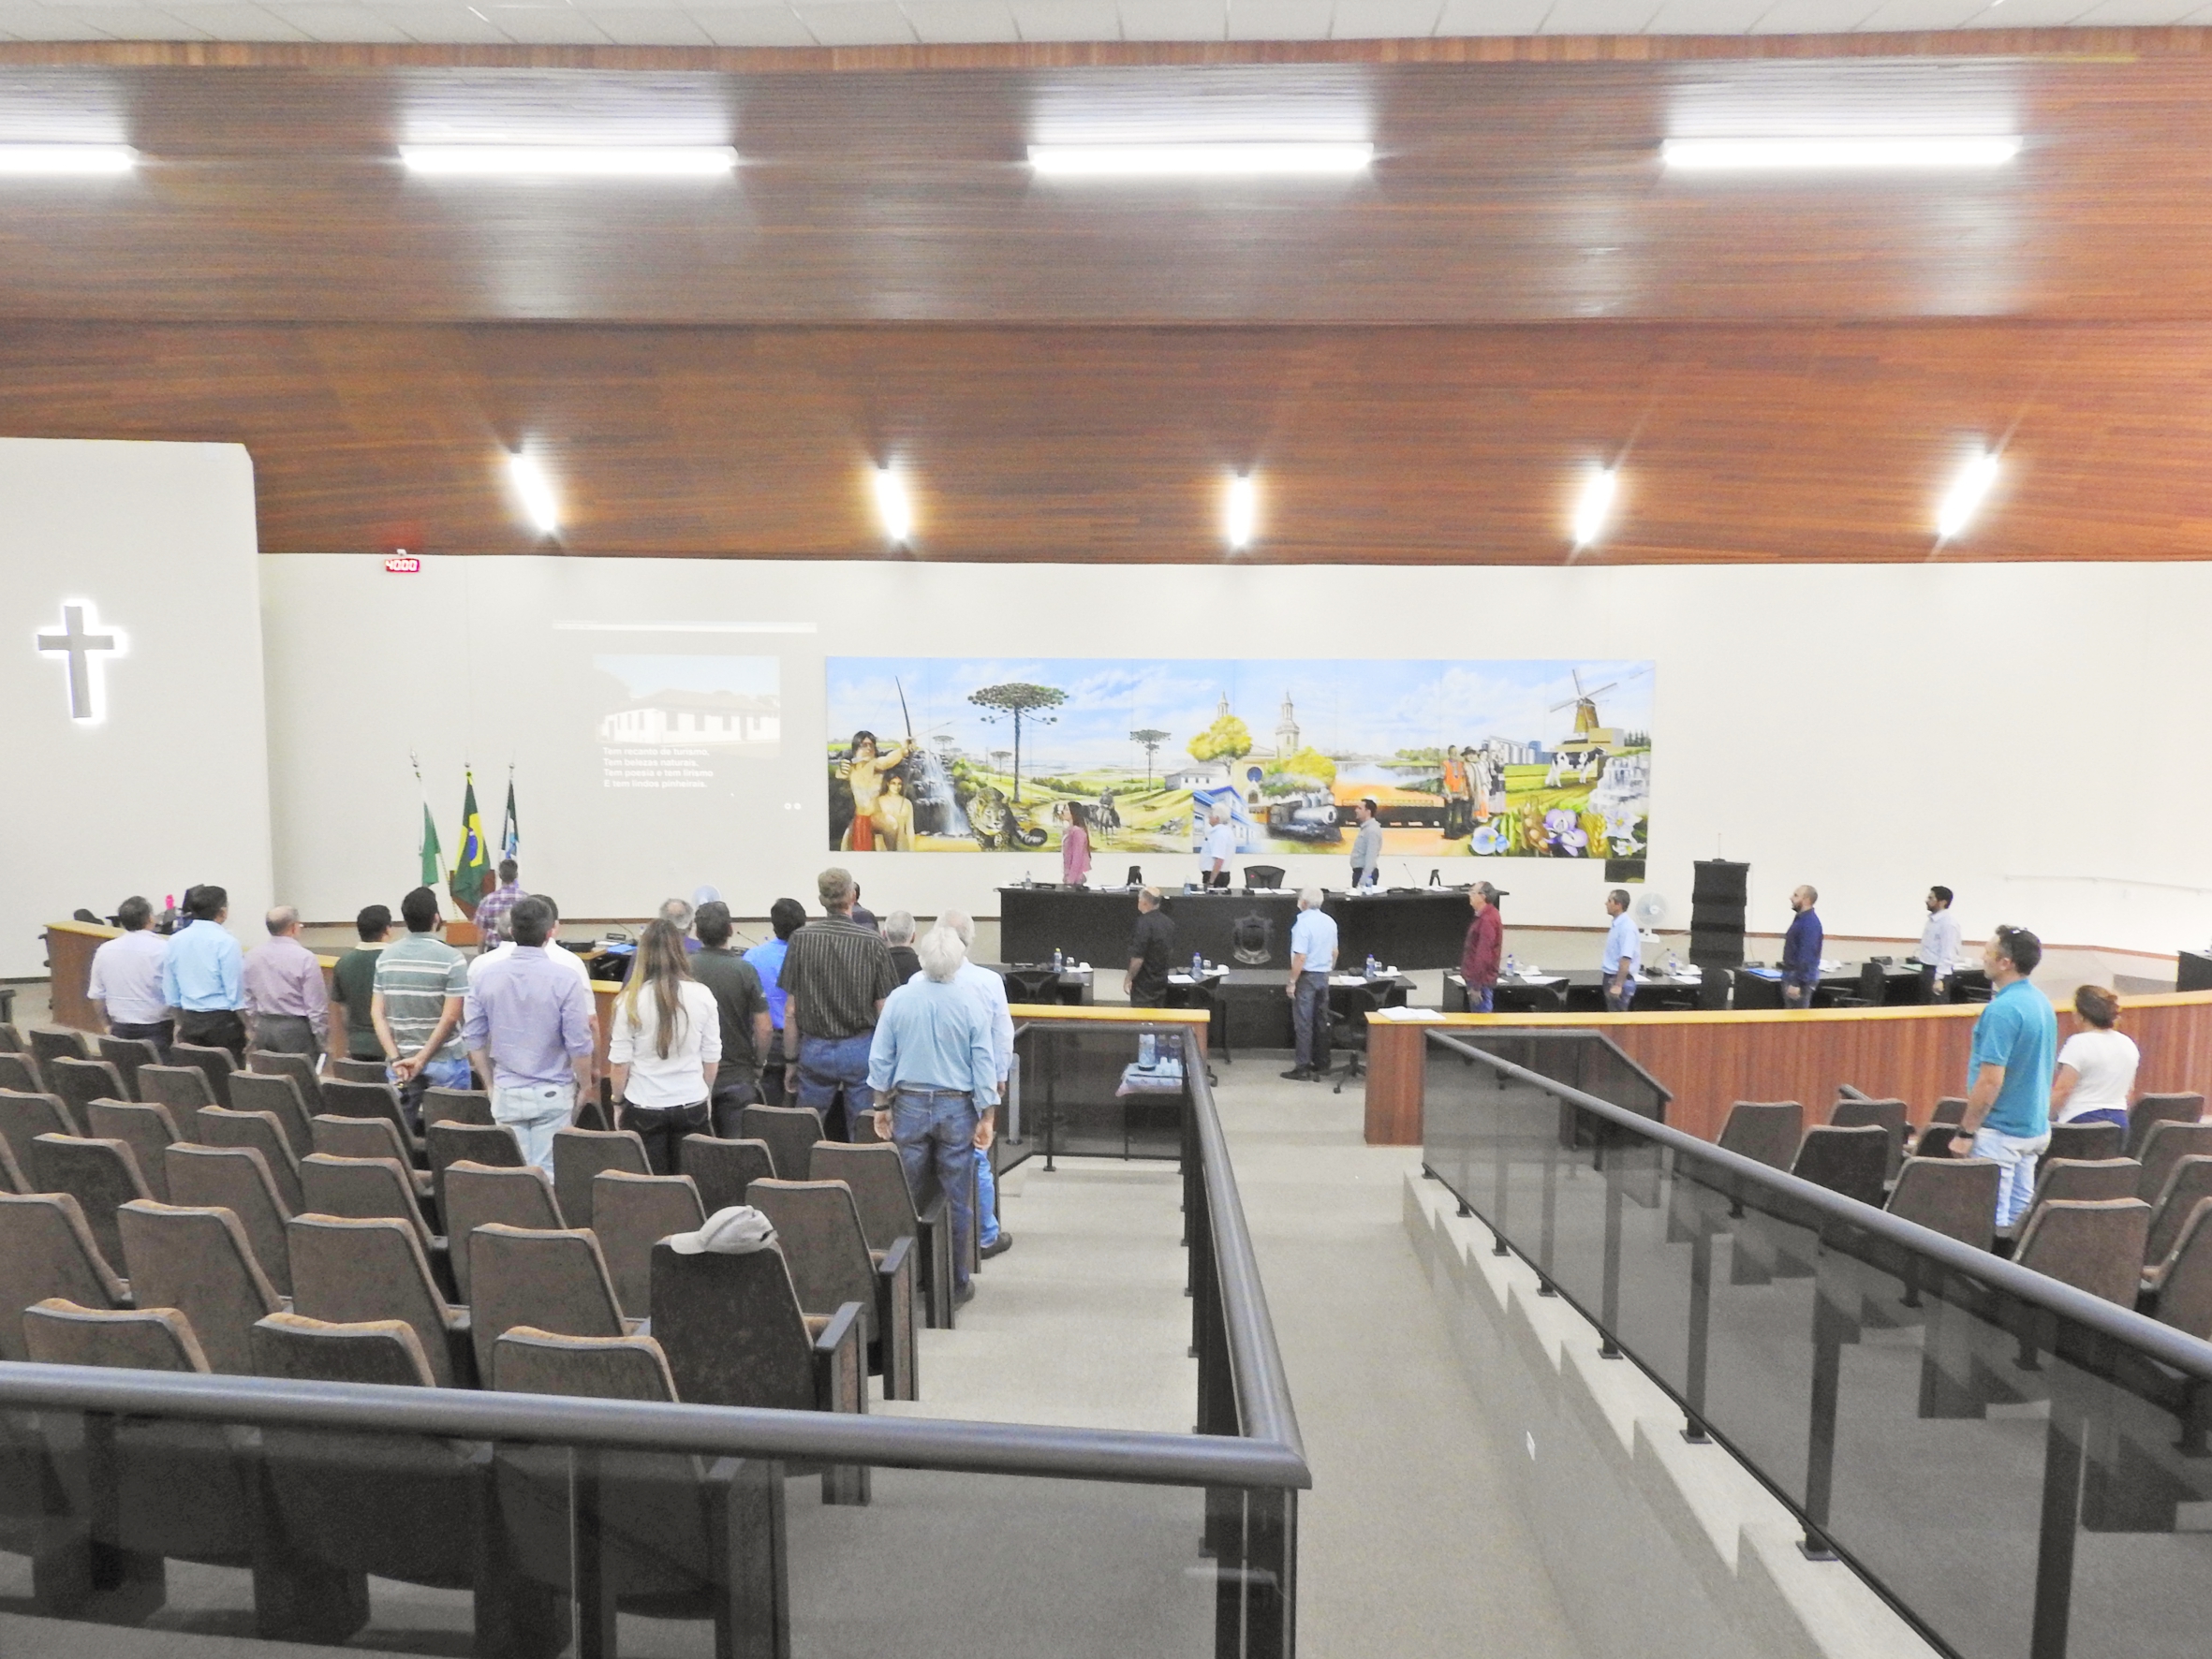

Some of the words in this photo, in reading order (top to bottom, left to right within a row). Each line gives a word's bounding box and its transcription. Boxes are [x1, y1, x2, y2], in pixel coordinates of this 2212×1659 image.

[602, 747, 622, 756] Tem
[624, 747, 658, 756] recanto
[602, 757, 623, 766] Tem
[624, 758, 658, 767] belezas
[603, 768, 623, 777] Tem
[624, 769, 655, 778] poesia
[683, 769, 714, 777] lirismo
[603, 779, 611, 787] E
[631, 779, 659, 788] lindos
